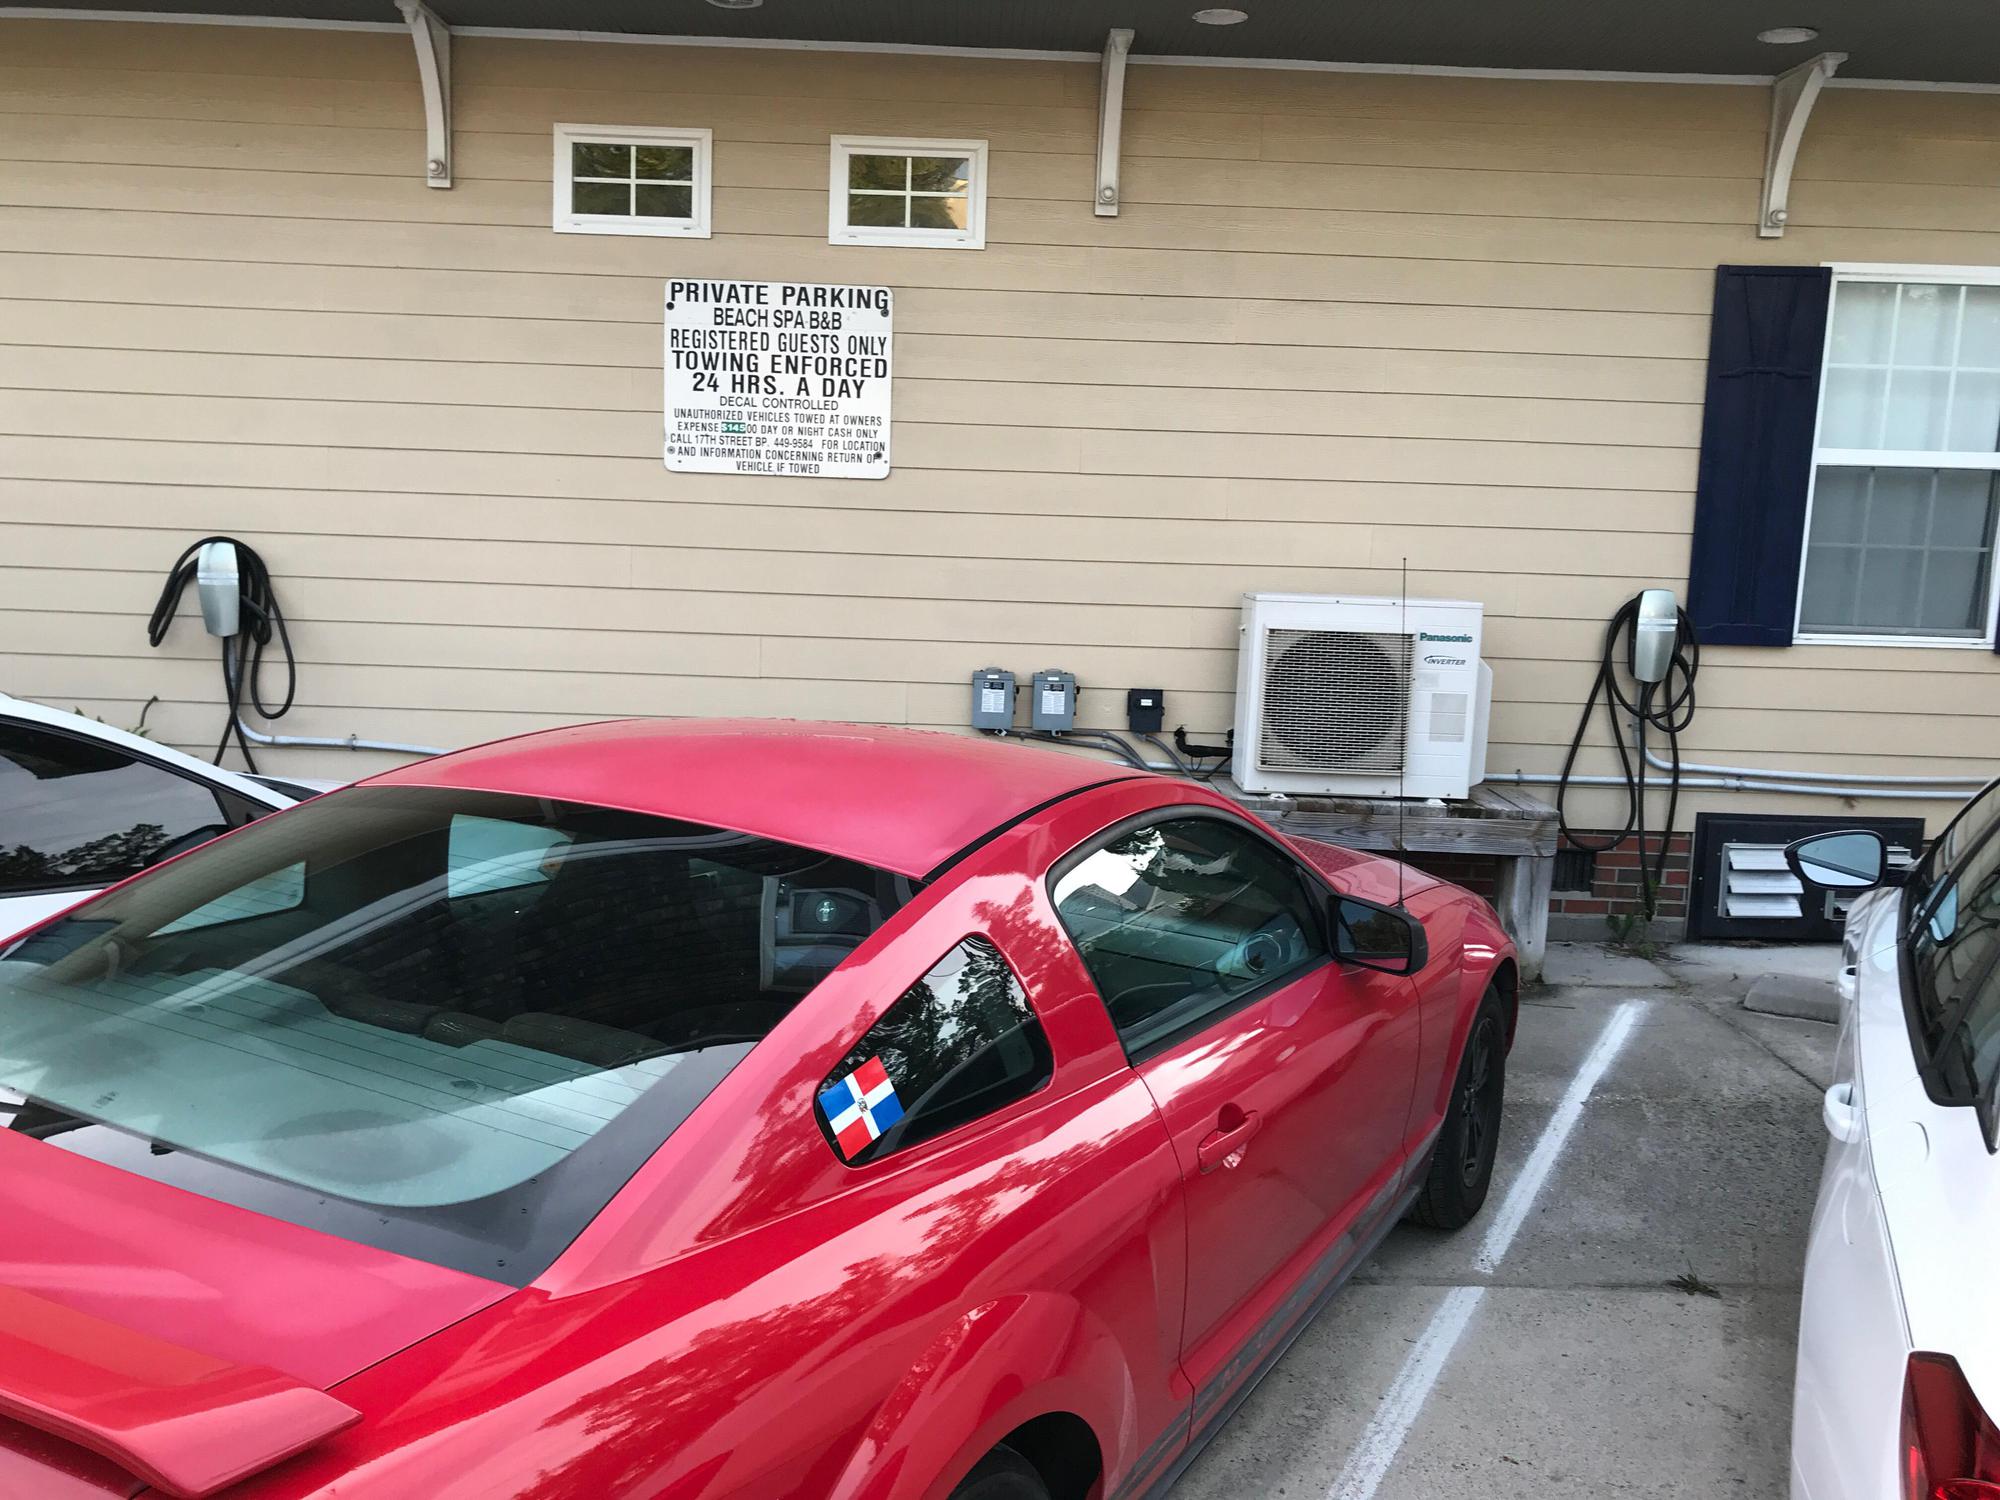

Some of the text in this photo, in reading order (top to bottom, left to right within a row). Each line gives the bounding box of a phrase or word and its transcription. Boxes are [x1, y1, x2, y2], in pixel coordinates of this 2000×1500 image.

[670, 282, 888, 311] PRIVATE PARKING
[714, 308, 842, 330] BEACH SPA B&B
[671, 329, 887, 356] REGISTERED GUESTS ONLY
[672, 350, 888, 378] TOWING ENFORCED
[692, 373, 865, 399] 24 HRS. A DAY
[720, 396, 838, 411] DECAL CONTROLLED
[674, 408, 882, 426] UNAUTHORIZED VEHICLES TOWED AT OWNERS
[677, 422, 719, 433] EXPENSE
[761, 425, 778, 435] DAY
[782, 426, 793, 435] OR
[797, 427, 824, 436] NIGHT
[828, 428, 853, 437] CASH
[856, 428, 878, 439] ONLY
[670, 433, 692, 443] CALL
[695, 435, 716, 445] 17TH
[719, 436, 753, 446] STREET
[774, 438, 813, 448] 449-9584
[822, 440, 839, 449] FOR
[843, 441, 885, 452] LOCATION
[677, 446, 696, 456] AND
[700, 447, 762, 459] INFORMATION
[765, 450, 823, 462] CONCERNING
[827, 452, 862, 463] RETURN
[736, 462, 819, 473] VEHICLE IF TOWED
[1419, 632, 1473, 643] Panasonic
